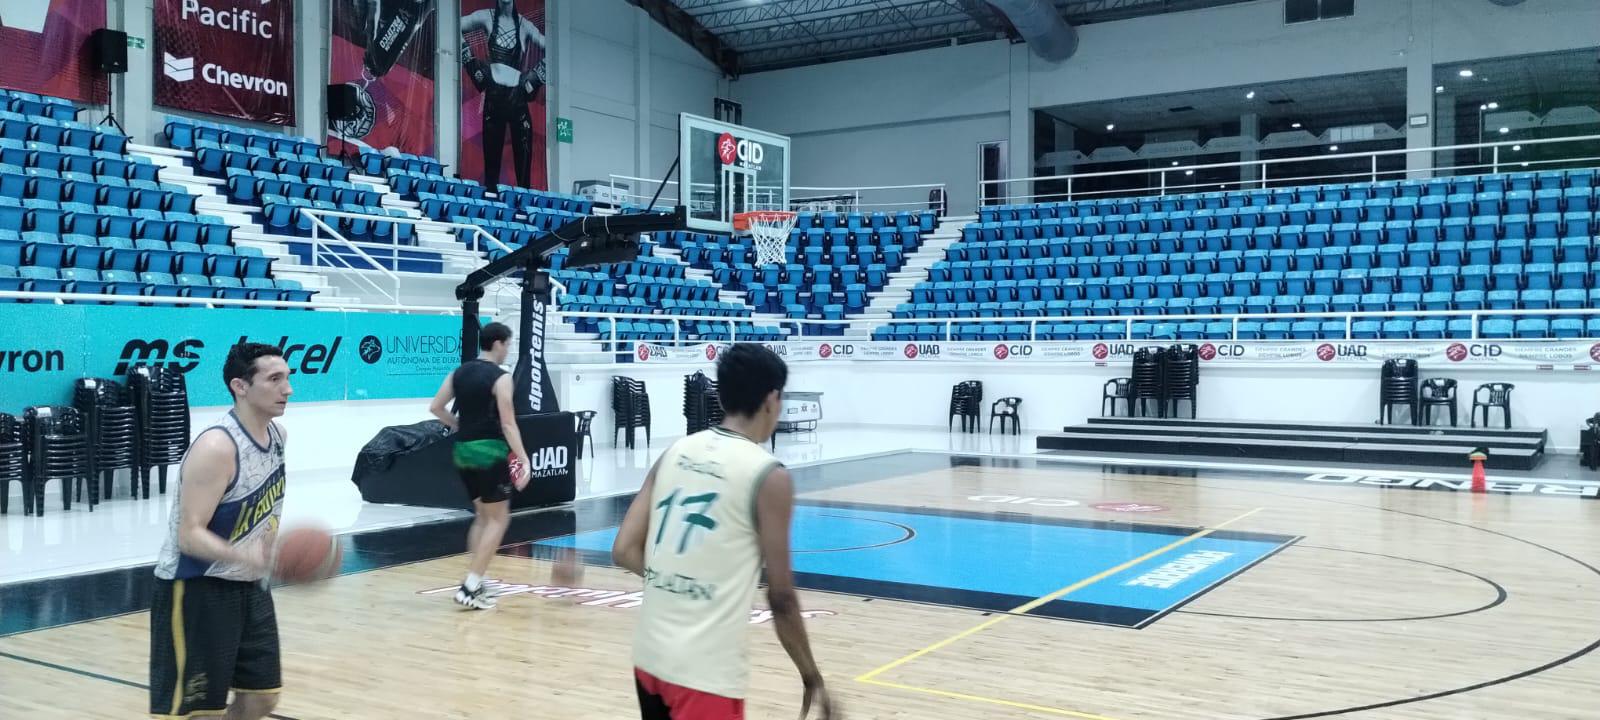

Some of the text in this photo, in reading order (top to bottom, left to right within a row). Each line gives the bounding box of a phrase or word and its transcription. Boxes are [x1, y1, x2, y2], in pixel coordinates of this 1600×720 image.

[182, 0, 273, 39] Pacific
[202, 63, 288, 97] Chevron
[737, 139, 764, 164] CID
[528, 297, 545, 412] dportenis
[832, 344, 854, 355] CID
[1009, 344, 1033, 356] CID
[1109, 343, 1135, 356] UAD
[1217, 344, 1245, 357] CID
[1469, 343, 1503, 356] CID
[431, 356, 441, 364] DE
[531, 468, 569, 479] MAZATLAN
[655, 487, 720, 555] 17
